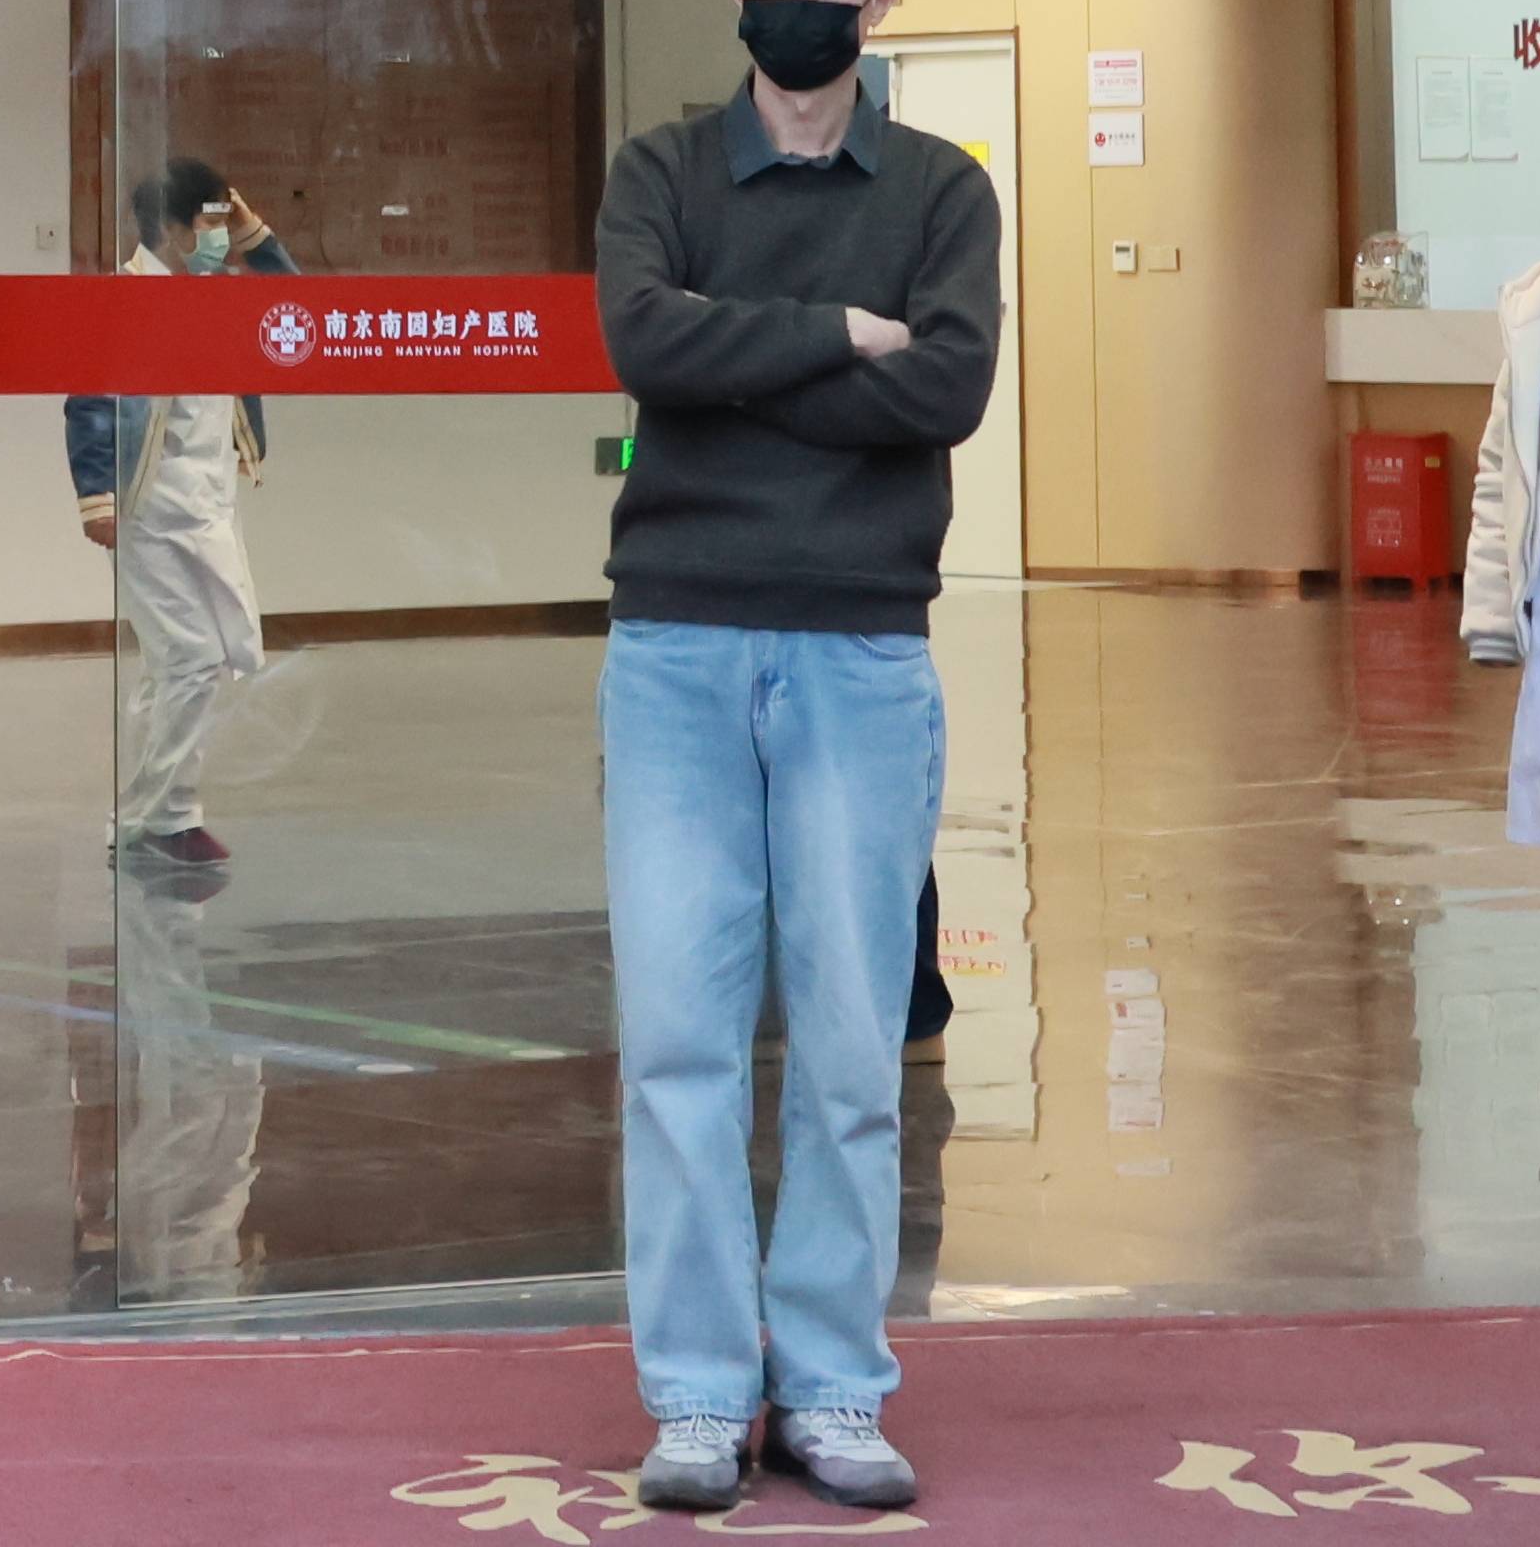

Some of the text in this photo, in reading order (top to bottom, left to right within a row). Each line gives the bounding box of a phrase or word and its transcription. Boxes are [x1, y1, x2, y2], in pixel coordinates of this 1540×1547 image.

[324, 309, 539, 339] 南京南园妇产医院
[323, 345, 539, 358] NANJING NANYUAN HOSPITAL
